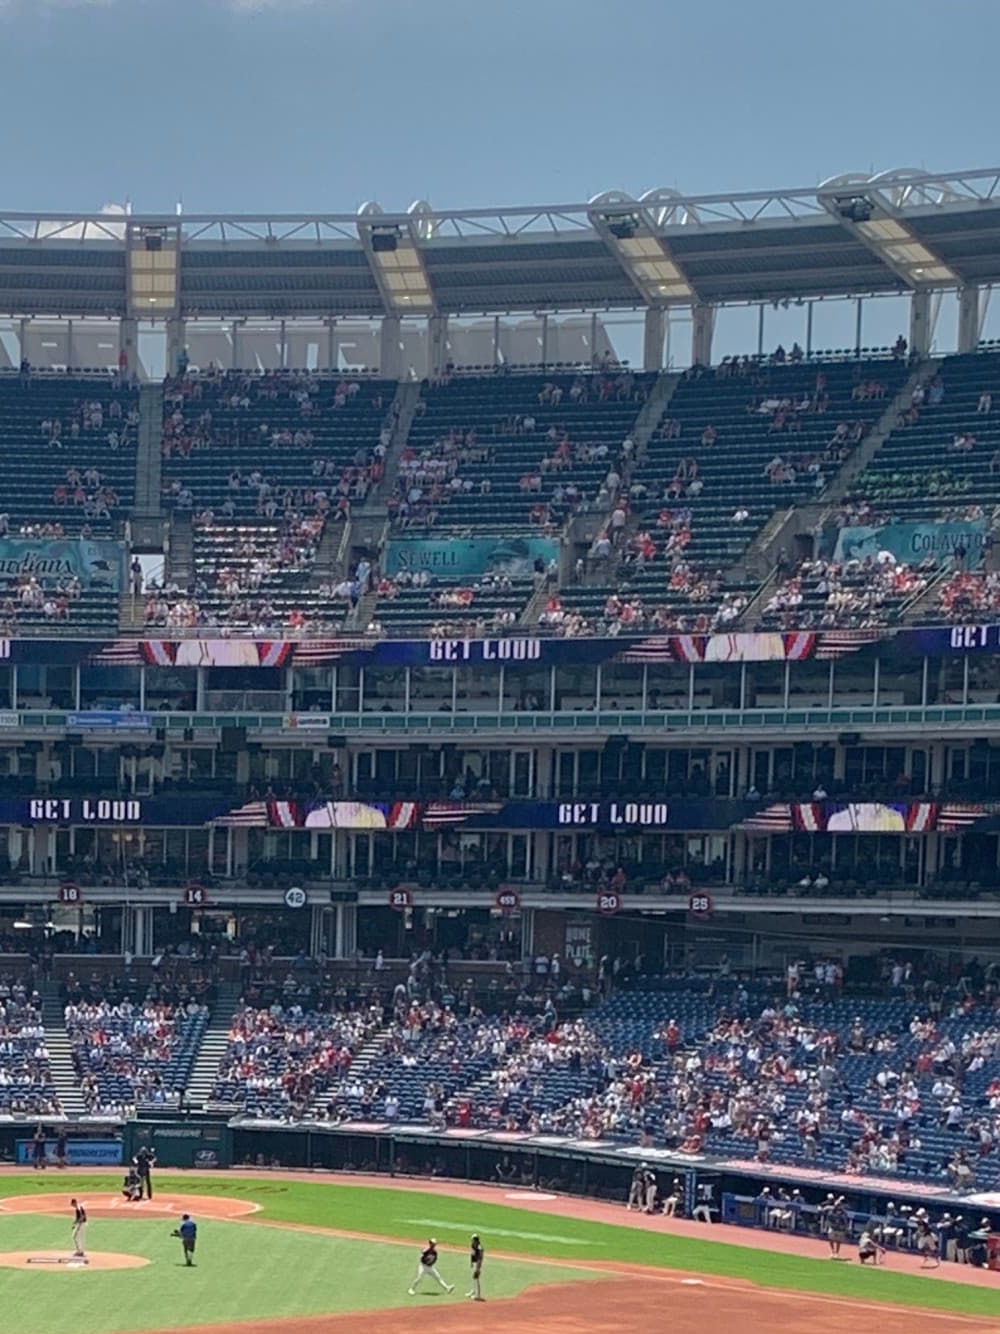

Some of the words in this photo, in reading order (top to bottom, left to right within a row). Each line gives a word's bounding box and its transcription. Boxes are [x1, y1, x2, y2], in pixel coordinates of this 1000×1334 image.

[398, 550, 460, 567] SEWELL
[951, 625, 988, 648] GET
[430, 640, 470, 659] GET
[483, 640, 540, 659] LOUD
[30, 800, 71, 819] GET
[83, 800, 140, 820] LOUD
[559, 803, 600, 823] GET
[610, 803, 668, 824] LOUD
[188, 890, 202, 902] 14
[287, 891, 304, 905] 42
[393, 892, 408, 904] 21
[600, 896, 617, 908] 20
[692, 898, 708, 910] 25
